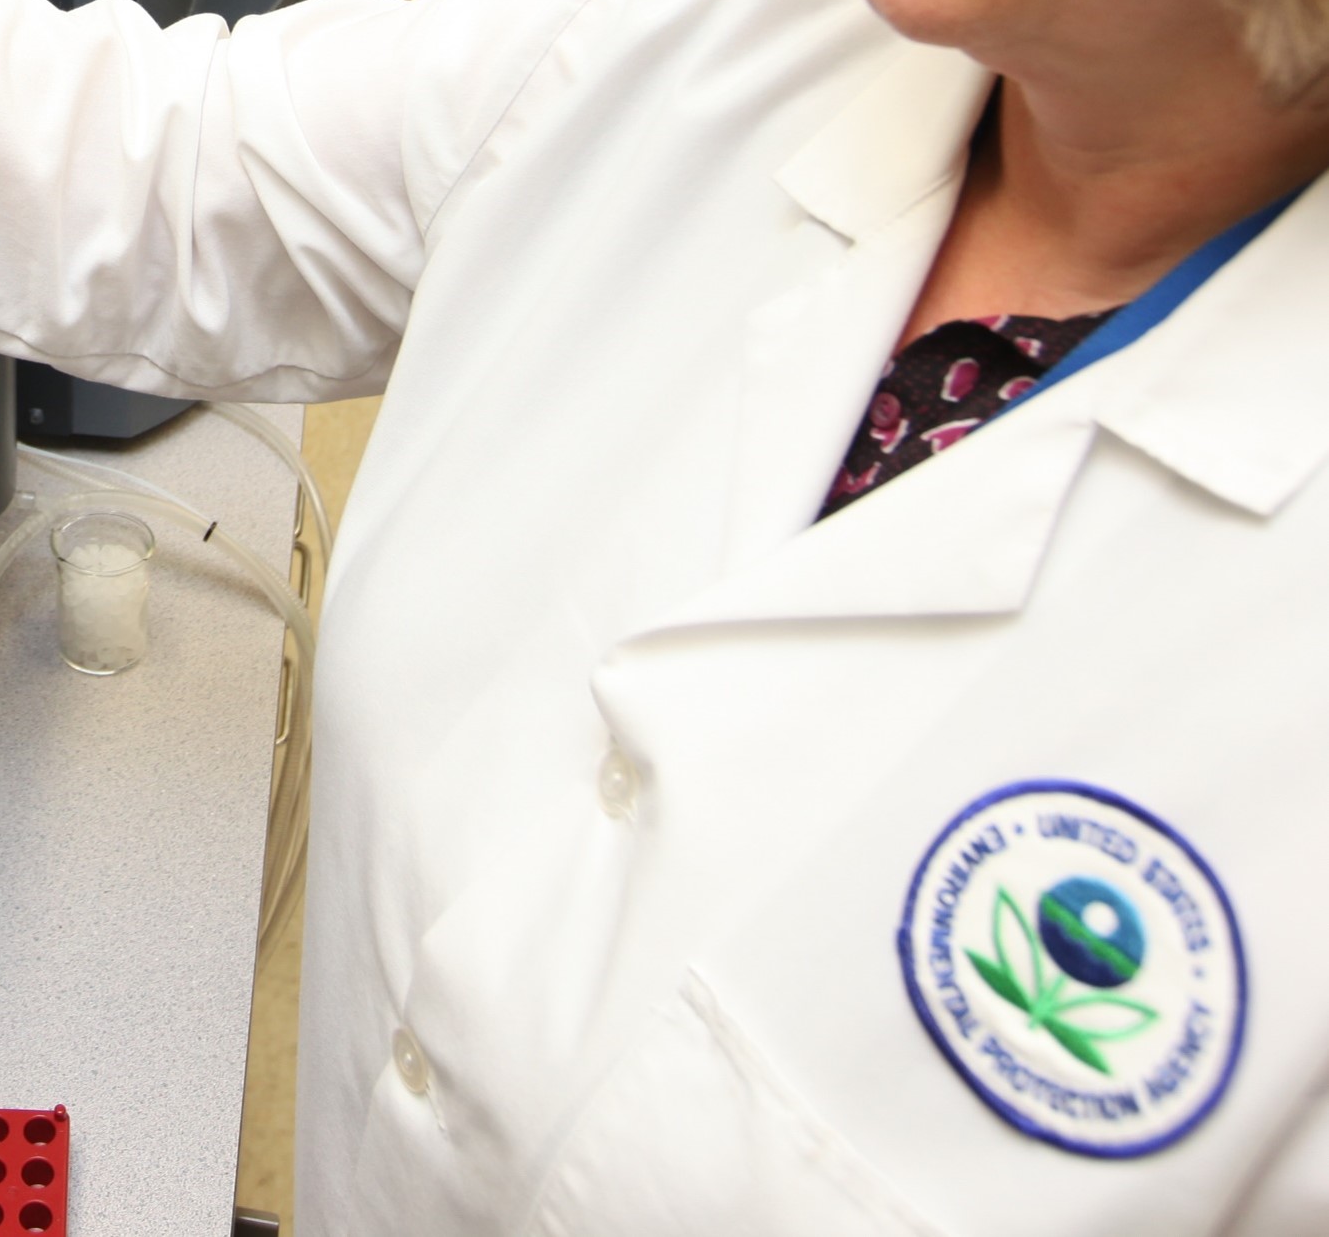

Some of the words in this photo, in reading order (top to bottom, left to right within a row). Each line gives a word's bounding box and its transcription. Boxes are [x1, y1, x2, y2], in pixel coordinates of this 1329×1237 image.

[930, 825, 1008, 1040] ENVIRONMENTAL
[980, 1036, 1141, 1120] PROTECTION
[1144, 1000, 1212, 1105] AGENCY
[1036, 813, 1139, 865] UNITED
[1141, 857, 1211, 952] STATES
